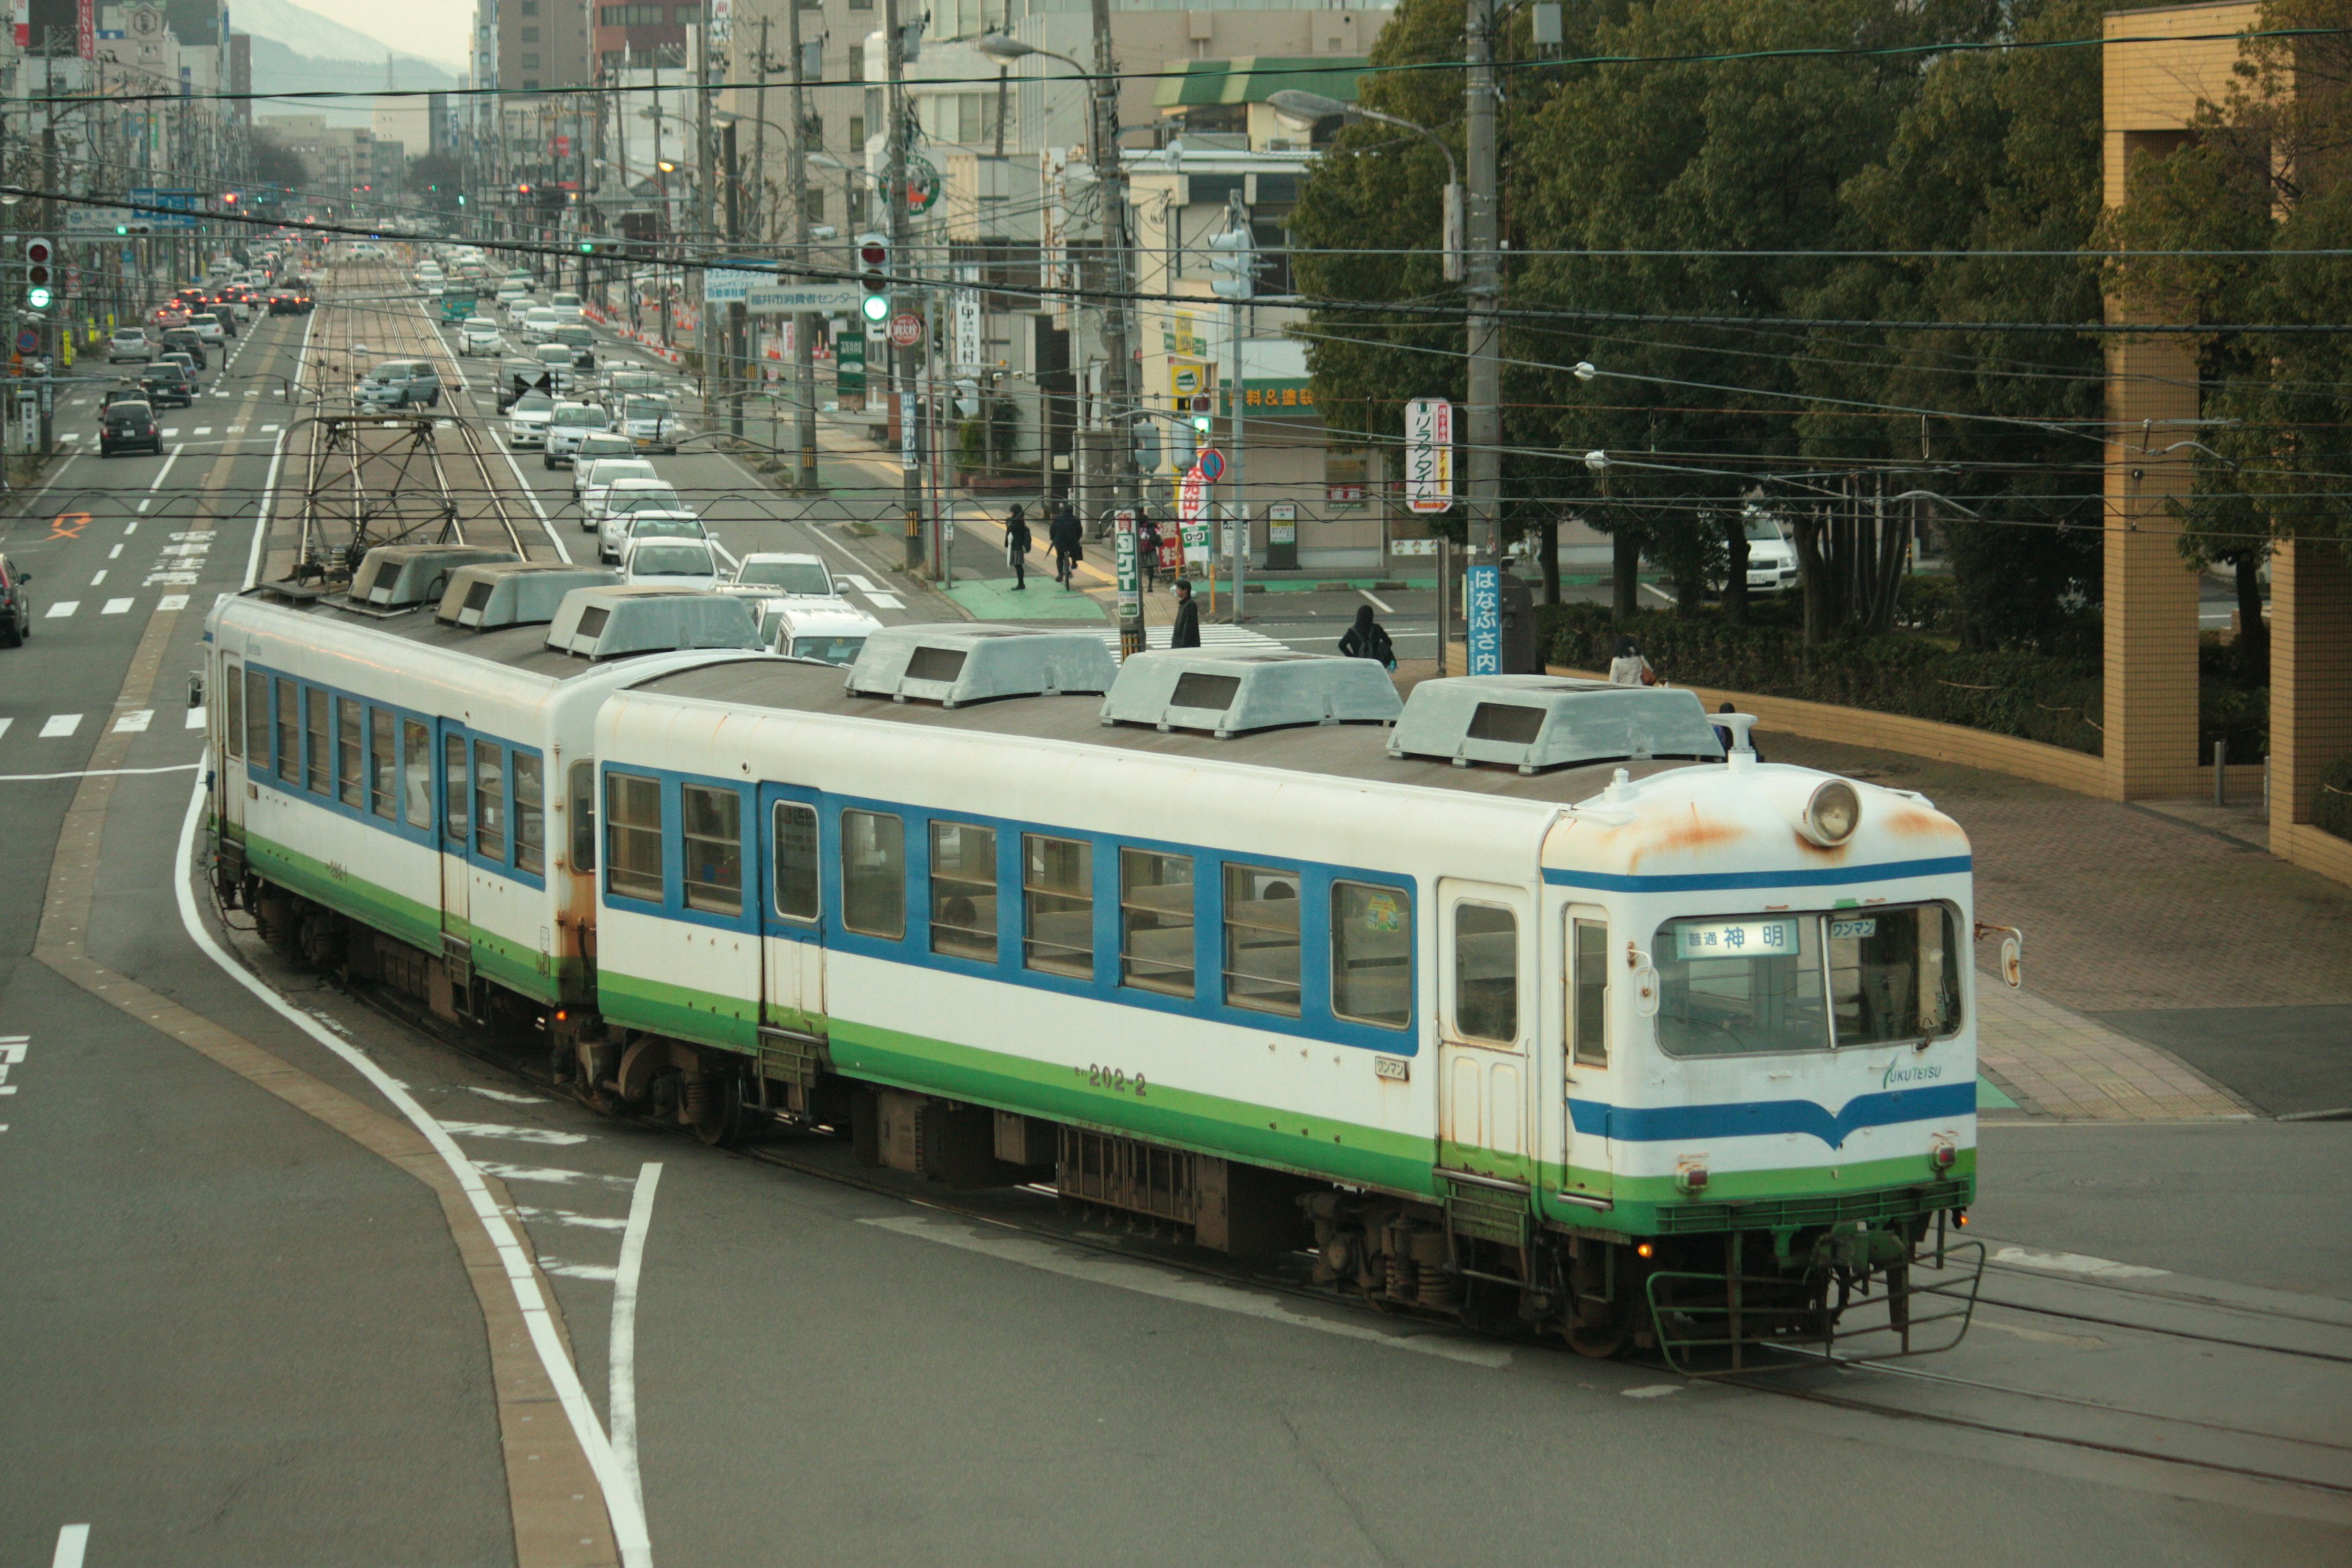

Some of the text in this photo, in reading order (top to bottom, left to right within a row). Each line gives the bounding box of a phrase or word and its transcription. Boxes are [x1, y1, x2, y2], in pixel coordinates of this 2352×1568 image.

[751, 292, 858, 306] 福井市消費者センター
[1414, 416, 1432, 499] リラクタイム
[1185, 532, 1203, 541] ロック
[1475, 570, 1496, 676] はなぶさ内
[1689, 924, 1784, 949] 普通 神明
[1833, 921, 1874, 937] ワンマン
[1378, 1060, 1403, 1076] ワンマン
